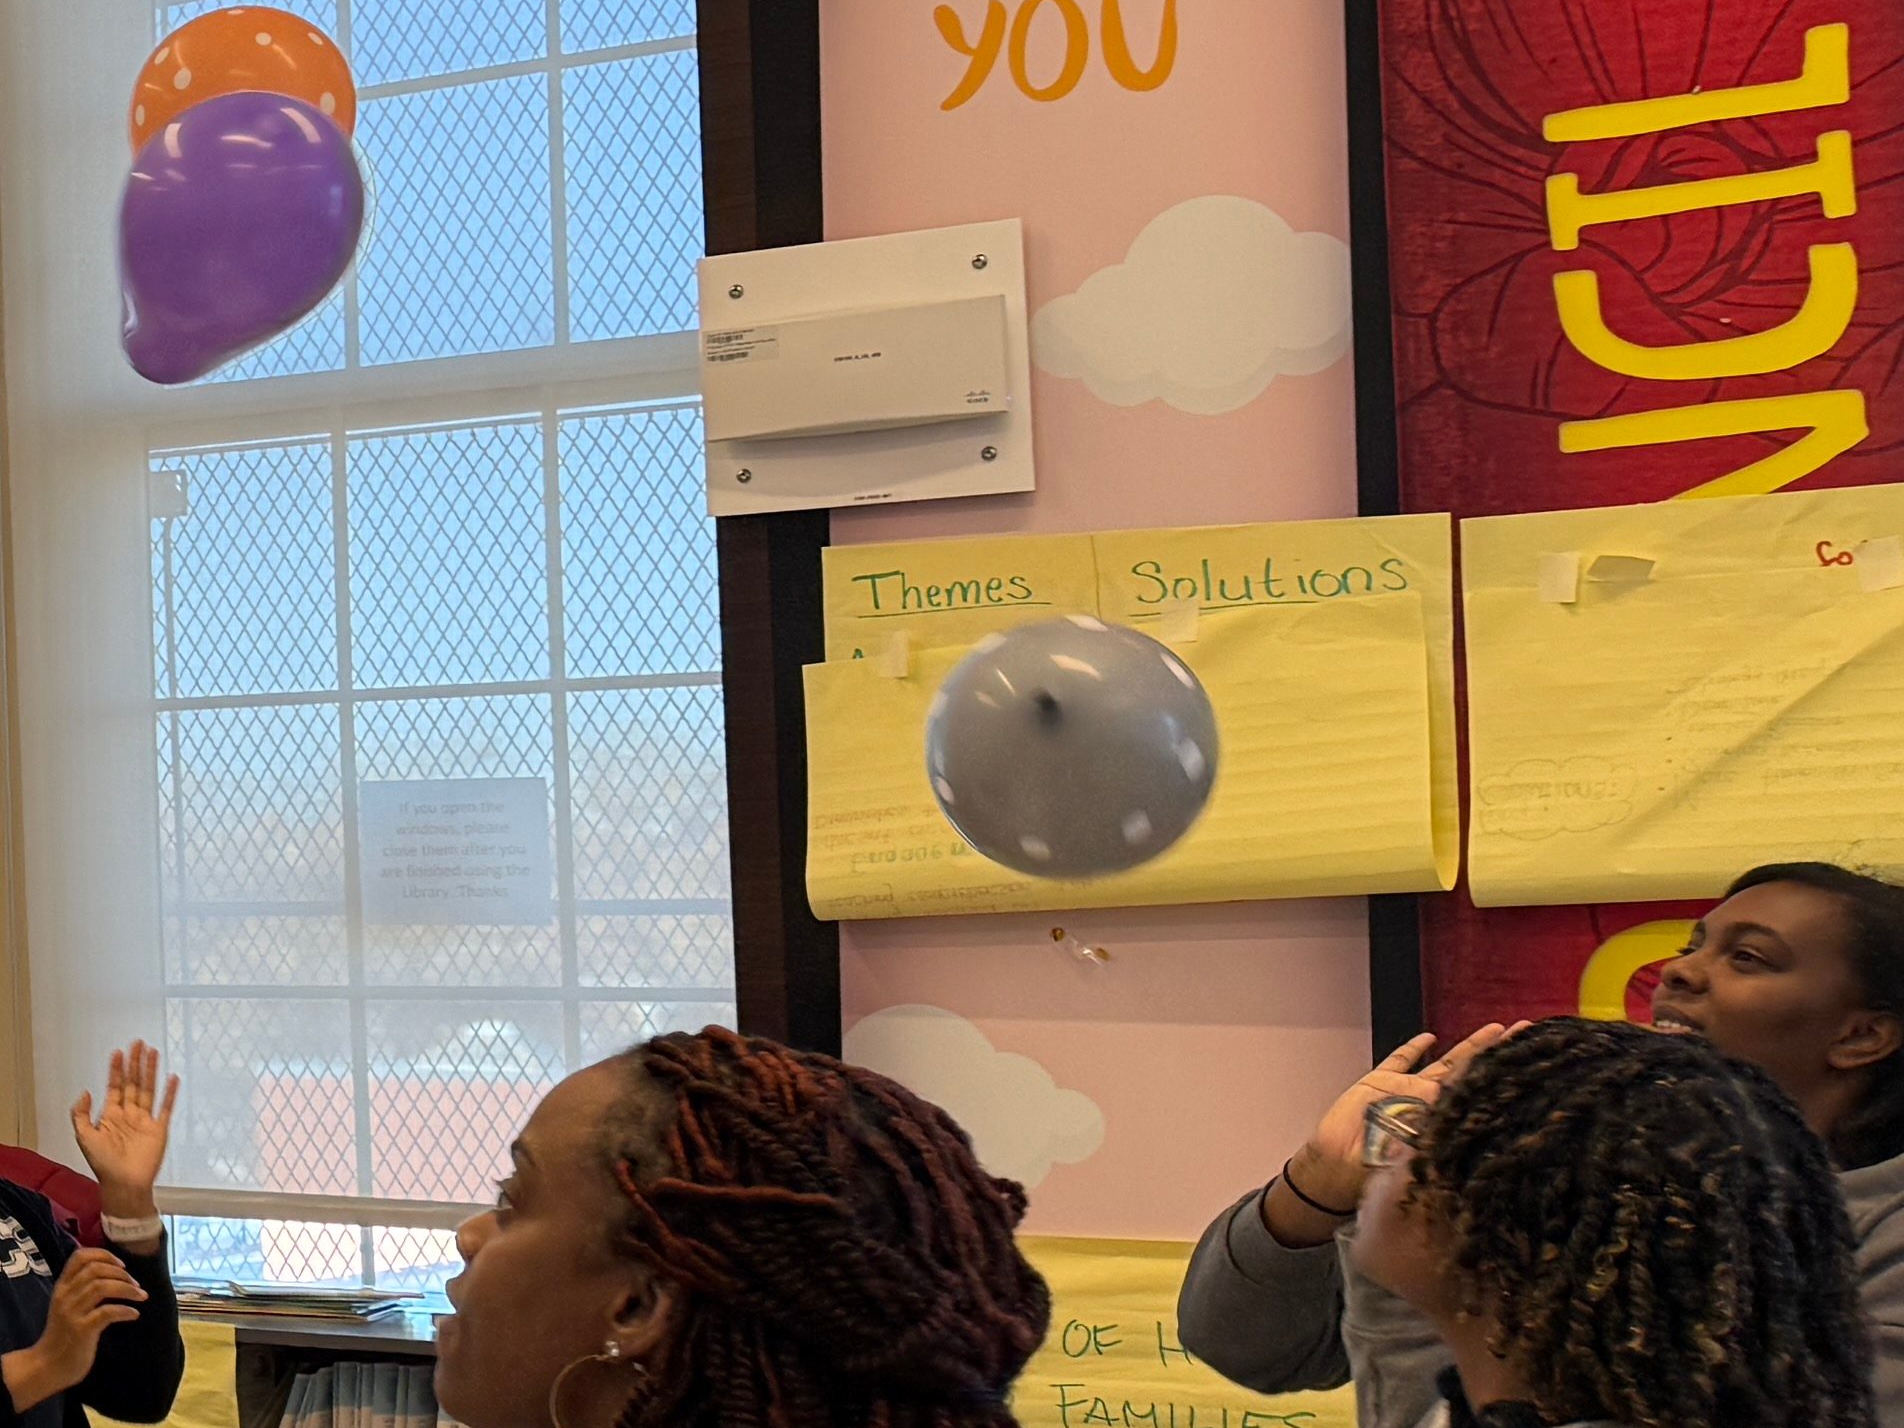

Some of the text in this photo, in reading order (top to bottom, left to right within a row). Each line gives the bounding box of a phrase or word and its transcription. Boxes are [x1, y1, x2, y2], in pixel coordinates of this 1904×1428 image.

[851, 556, 1410, 612] Themes Solutions
[1061, 1318, 1123, 1358] OF
